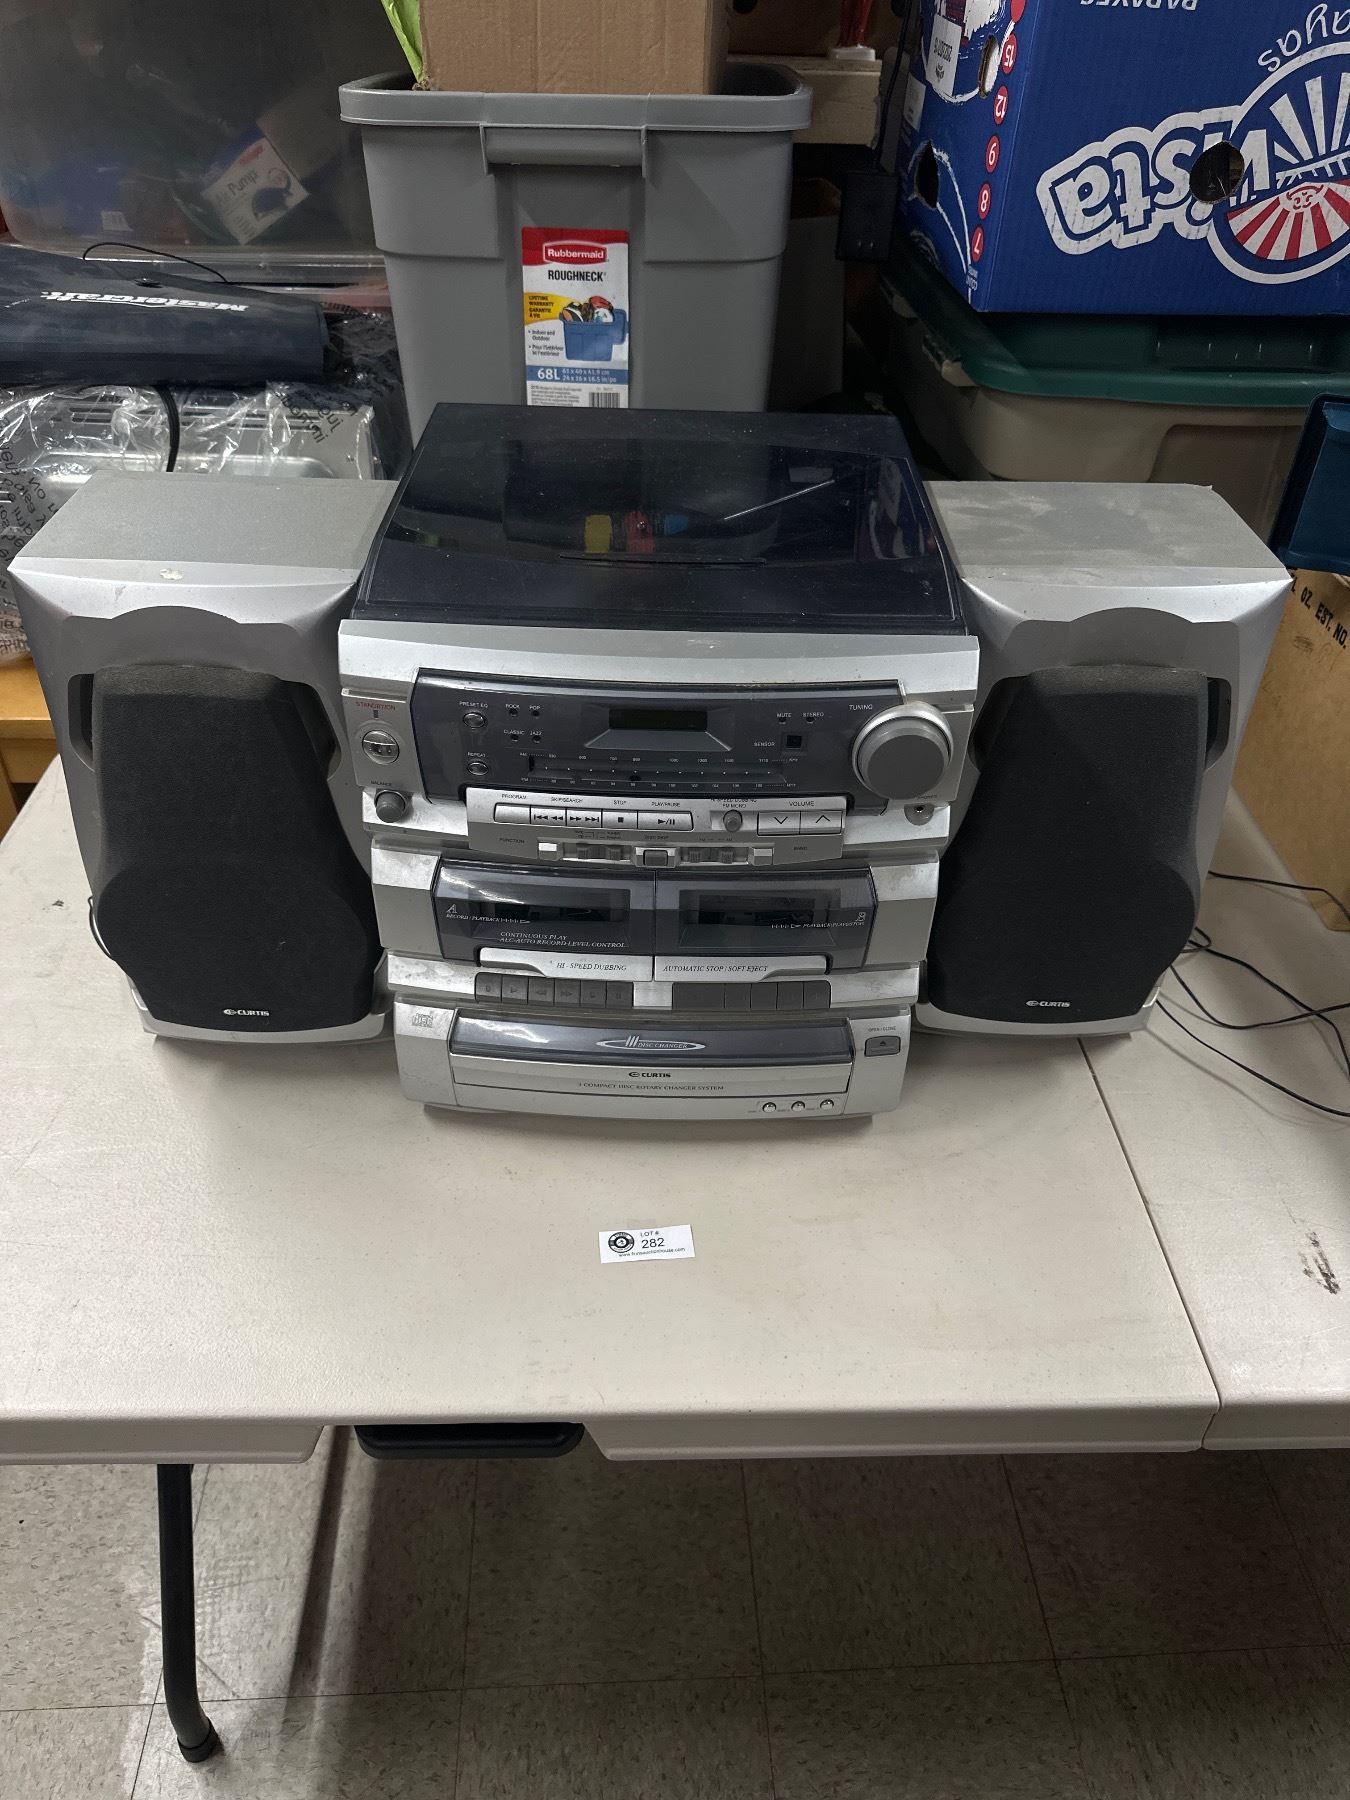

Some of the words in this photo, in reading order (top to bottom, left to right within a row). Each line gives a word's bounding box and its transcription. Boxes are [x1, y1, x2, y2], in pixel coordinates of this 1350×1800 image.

[1003, 44, 1015, 67] 15
[995, 94, 1007, 118] 12
[981, 190, 988, 212] 8
[974, 232, 981, 253] 7
[547, 248, 604, 260] Rubbermaid
[547, 270, 604, 282] ROUGHNECK
[41, 290, 249, 312] Mastercraft
[537, 367, 560, 380] 68L
[1300, 586, 1313, 610] OZ
[1315, 601, 1334, 632] EST.
[1333, 623, 1348, 649] NO.
[446, 903, 457, 914] A
[500, 931, 548, 940] CONTINUOUS
[593, 963, 627, 971] DUBBING
[746, 965, 768, 973] EJECT
[641, 1237, 665, 1249] 282
